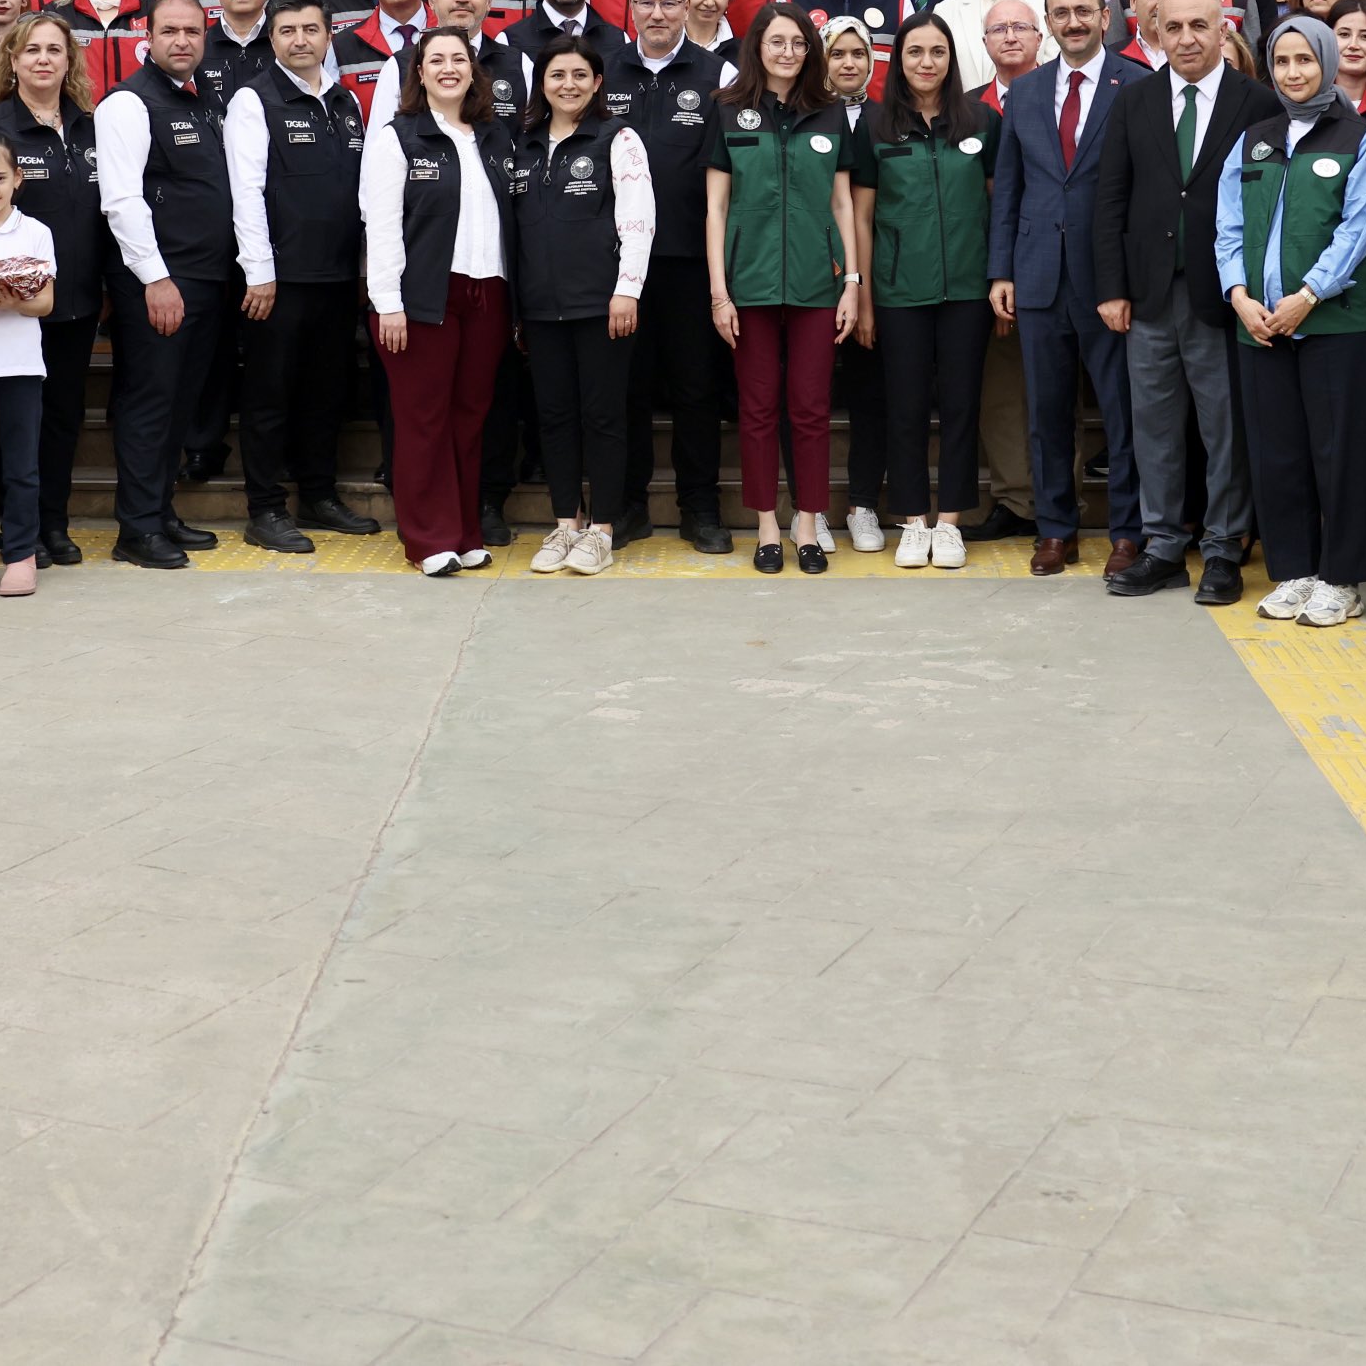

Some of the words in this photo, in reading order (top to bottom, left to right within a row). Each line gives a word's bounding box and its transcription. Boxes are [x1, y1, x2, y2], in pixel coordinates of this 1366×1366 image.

[606, 93, 632, 101] TAGEM
[170, 122, 194, 131] TAGEM
[284, 120, 311, 130] TAGEM
[17, 156, 45, 166] TAGEM
[412, 158, 439, 168] TAGEM
